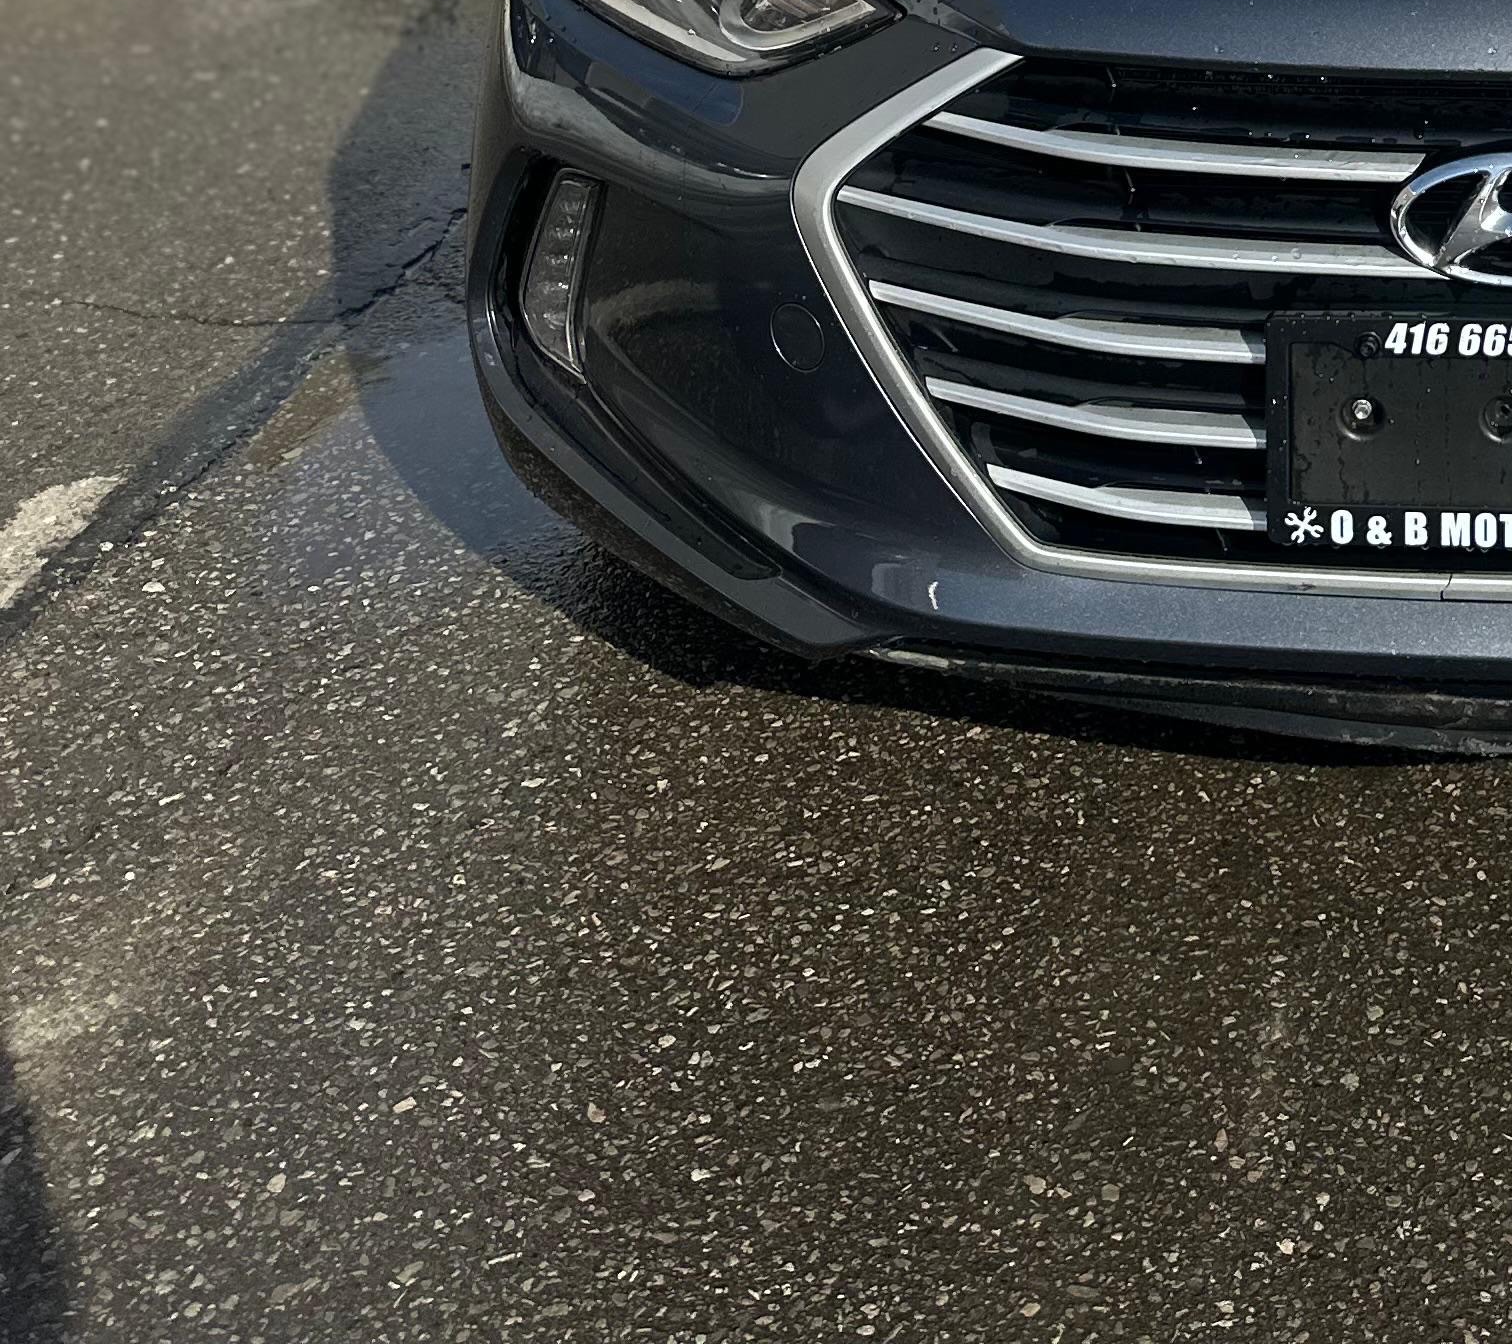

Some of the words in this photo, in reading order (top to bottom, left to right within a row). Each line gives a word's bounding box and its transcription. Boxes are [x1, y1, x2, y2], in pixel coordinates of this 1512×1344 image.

[1384, 321, 1450, 356] 416
[1330, 509, 1354, 545] O
[1366, 515, 1393, 545] &
[1404, 511, 1429, 546] B
